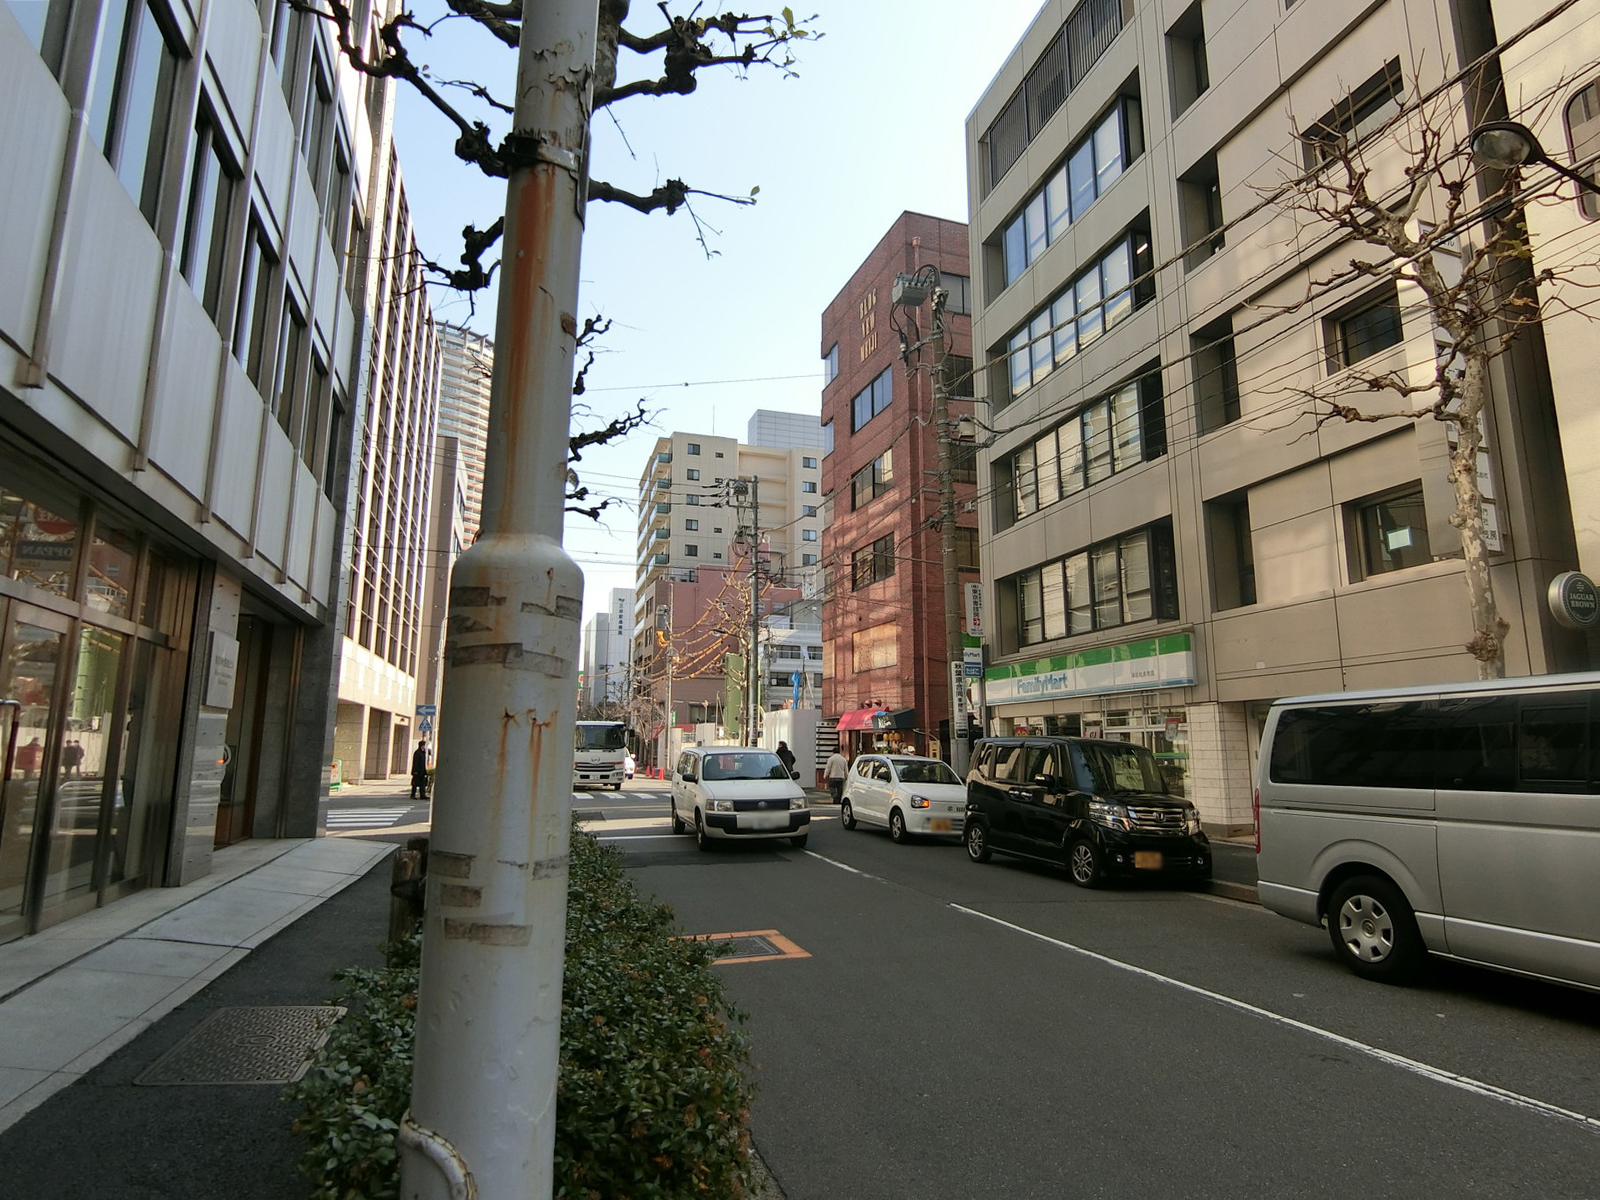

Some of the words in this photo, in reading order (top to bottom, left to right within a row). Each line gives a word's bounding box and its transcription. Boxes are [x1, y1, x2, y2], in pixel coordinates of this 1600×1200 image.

[1569, 593, 1595, 601] JAGUAR
[1570, 600, 1596, 609] BROWN
[1016, 673, 1068, 695] FamilyMart
